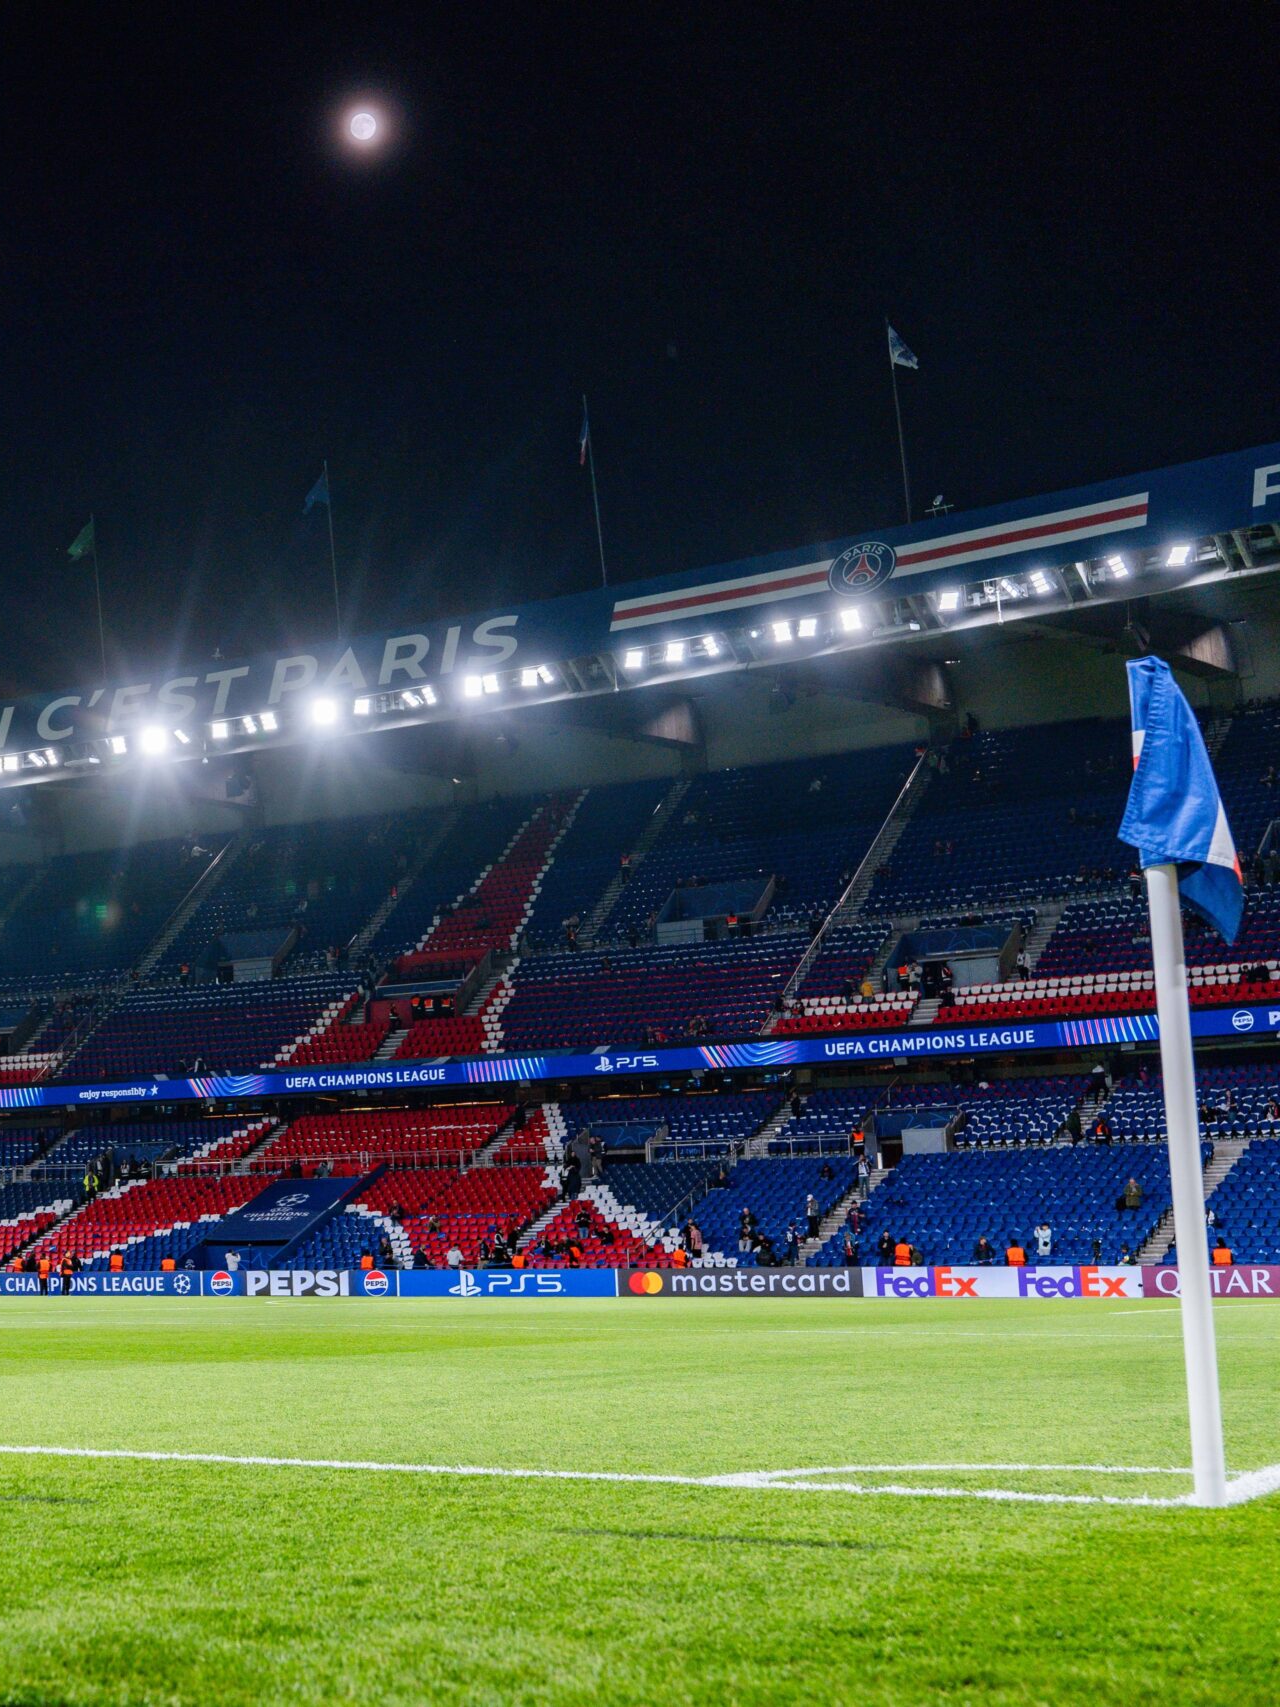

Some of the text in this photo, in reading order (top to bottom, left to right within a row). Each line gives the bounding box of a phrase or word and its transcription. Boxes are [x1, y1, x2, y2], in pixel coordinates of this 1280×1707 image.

[843, 544, 885, 561] PARIS
[36, 665, 249, 733] C'EST
[268, 615, 519, 704] PARIS
[825, 1030, 1035, 1055] UEFA CHAMPIONS LEAGUE
[616, 1055, 658, 1068] PS5
[285, 1068, 446, 1089] UEFA CHAMPIONS LEAGUE
[79, 1087, 147, 1100] enjoy responsibly
[103, 1276, 165, 1292] LEAGUE
[246, 1270, 349, 1296] PEPSI
[365, 1280, 387, 1288] PEPSI
[487, 1273, 562, 1293] PS5
[671, 1270, 850, 1293] mastercard
[875, 1266, 978, 1297] FedEx
[1017, 1266, 1126, 1297] FedEx
[1154, 1269, 1274, 1298] QTAR
